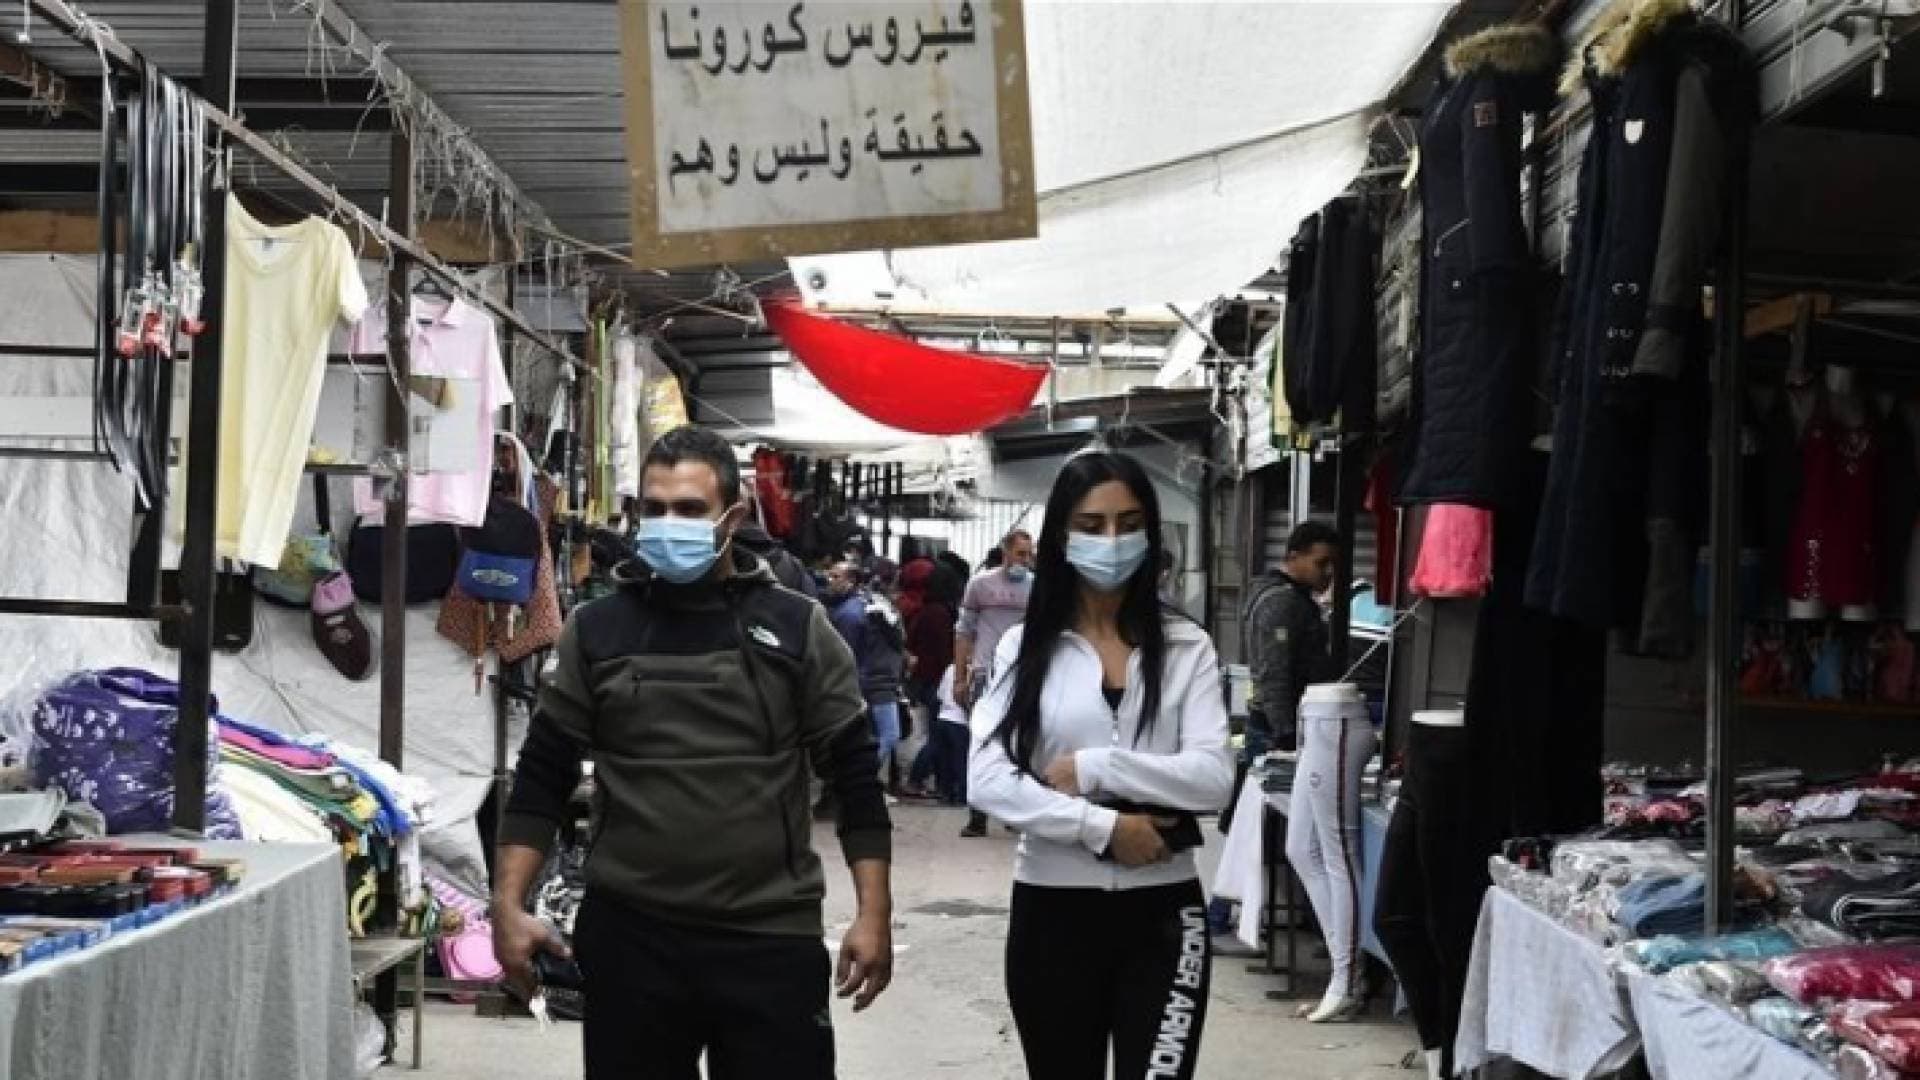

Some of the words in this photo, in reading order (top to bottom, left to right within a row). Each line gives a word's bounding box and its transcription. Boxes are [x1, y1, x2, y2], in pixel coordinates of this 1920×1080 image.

[661, 3, 808, 76] كورونا
[825, 0, 976, 67] فيروس
[669, 136, 740, 196] وهم
[753, 118, 852, 184] وليس
[864, 107, 983, 175] حقيقة
[1174, 906, 1205, 988] UNDER
